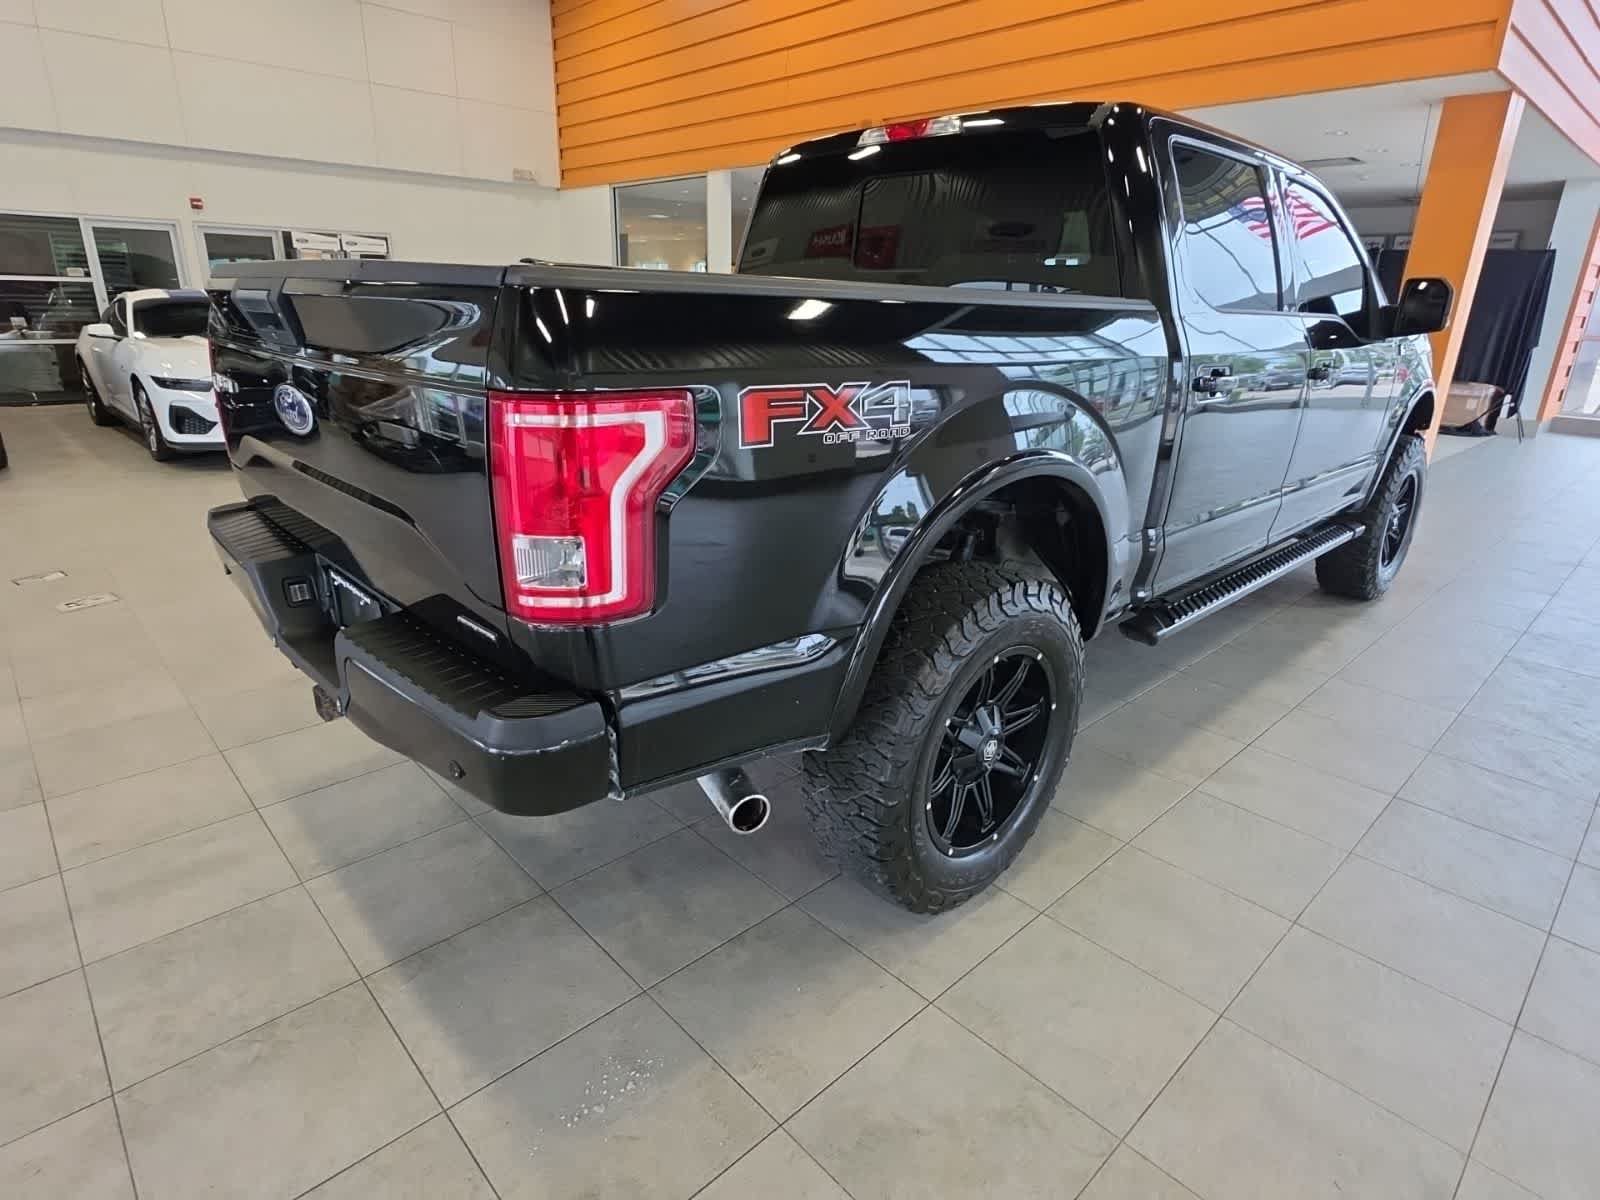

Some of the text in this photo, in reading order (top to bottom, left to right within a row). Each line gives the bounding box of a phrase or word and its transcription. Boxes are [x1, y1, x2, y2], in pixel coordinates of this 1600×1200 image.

[737, 380, 912, 449] FX4
[823, 426, 912, 445] OFF ROAD
